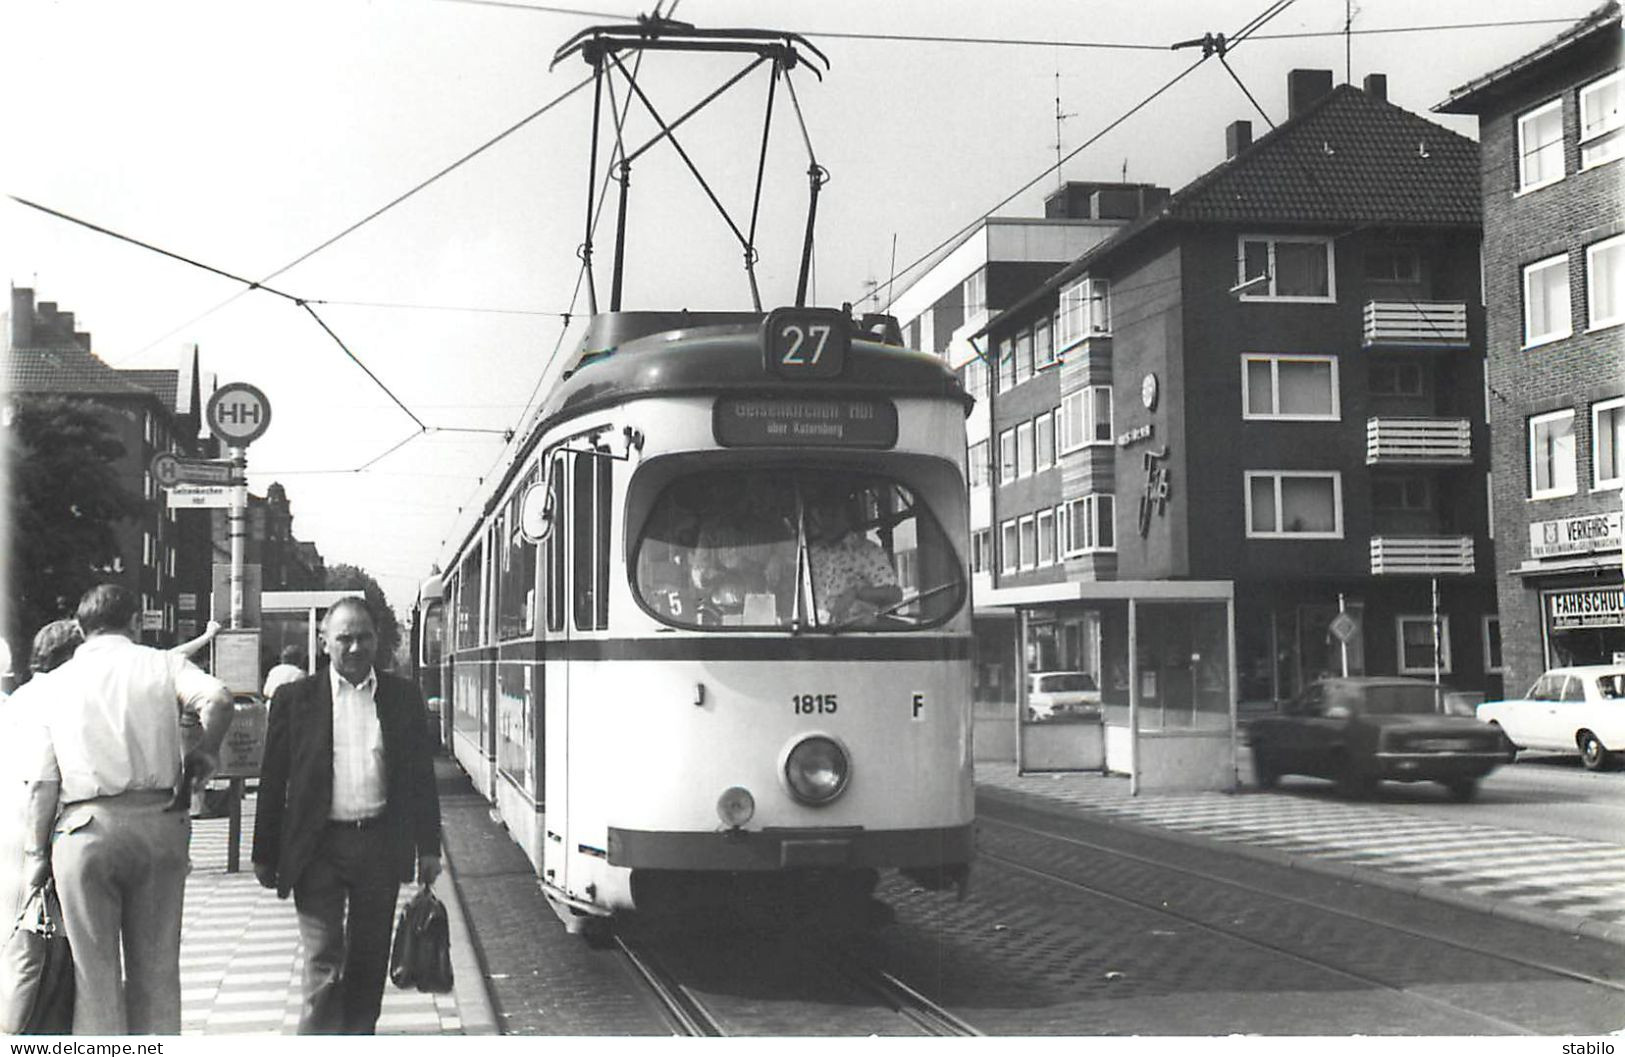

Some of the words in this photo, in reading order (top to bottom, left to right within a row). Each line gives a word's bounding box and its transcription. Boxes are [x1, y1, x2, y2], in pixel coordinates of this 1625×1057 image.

[781, 325, 831, 365] 27
[218, 402, 260, 424] HH
[161, 461, 176, 479] H
[667, 591, 682, 616] 5
[792, 694, 838, 714] 1815
[912, 694, 924, 717] F
